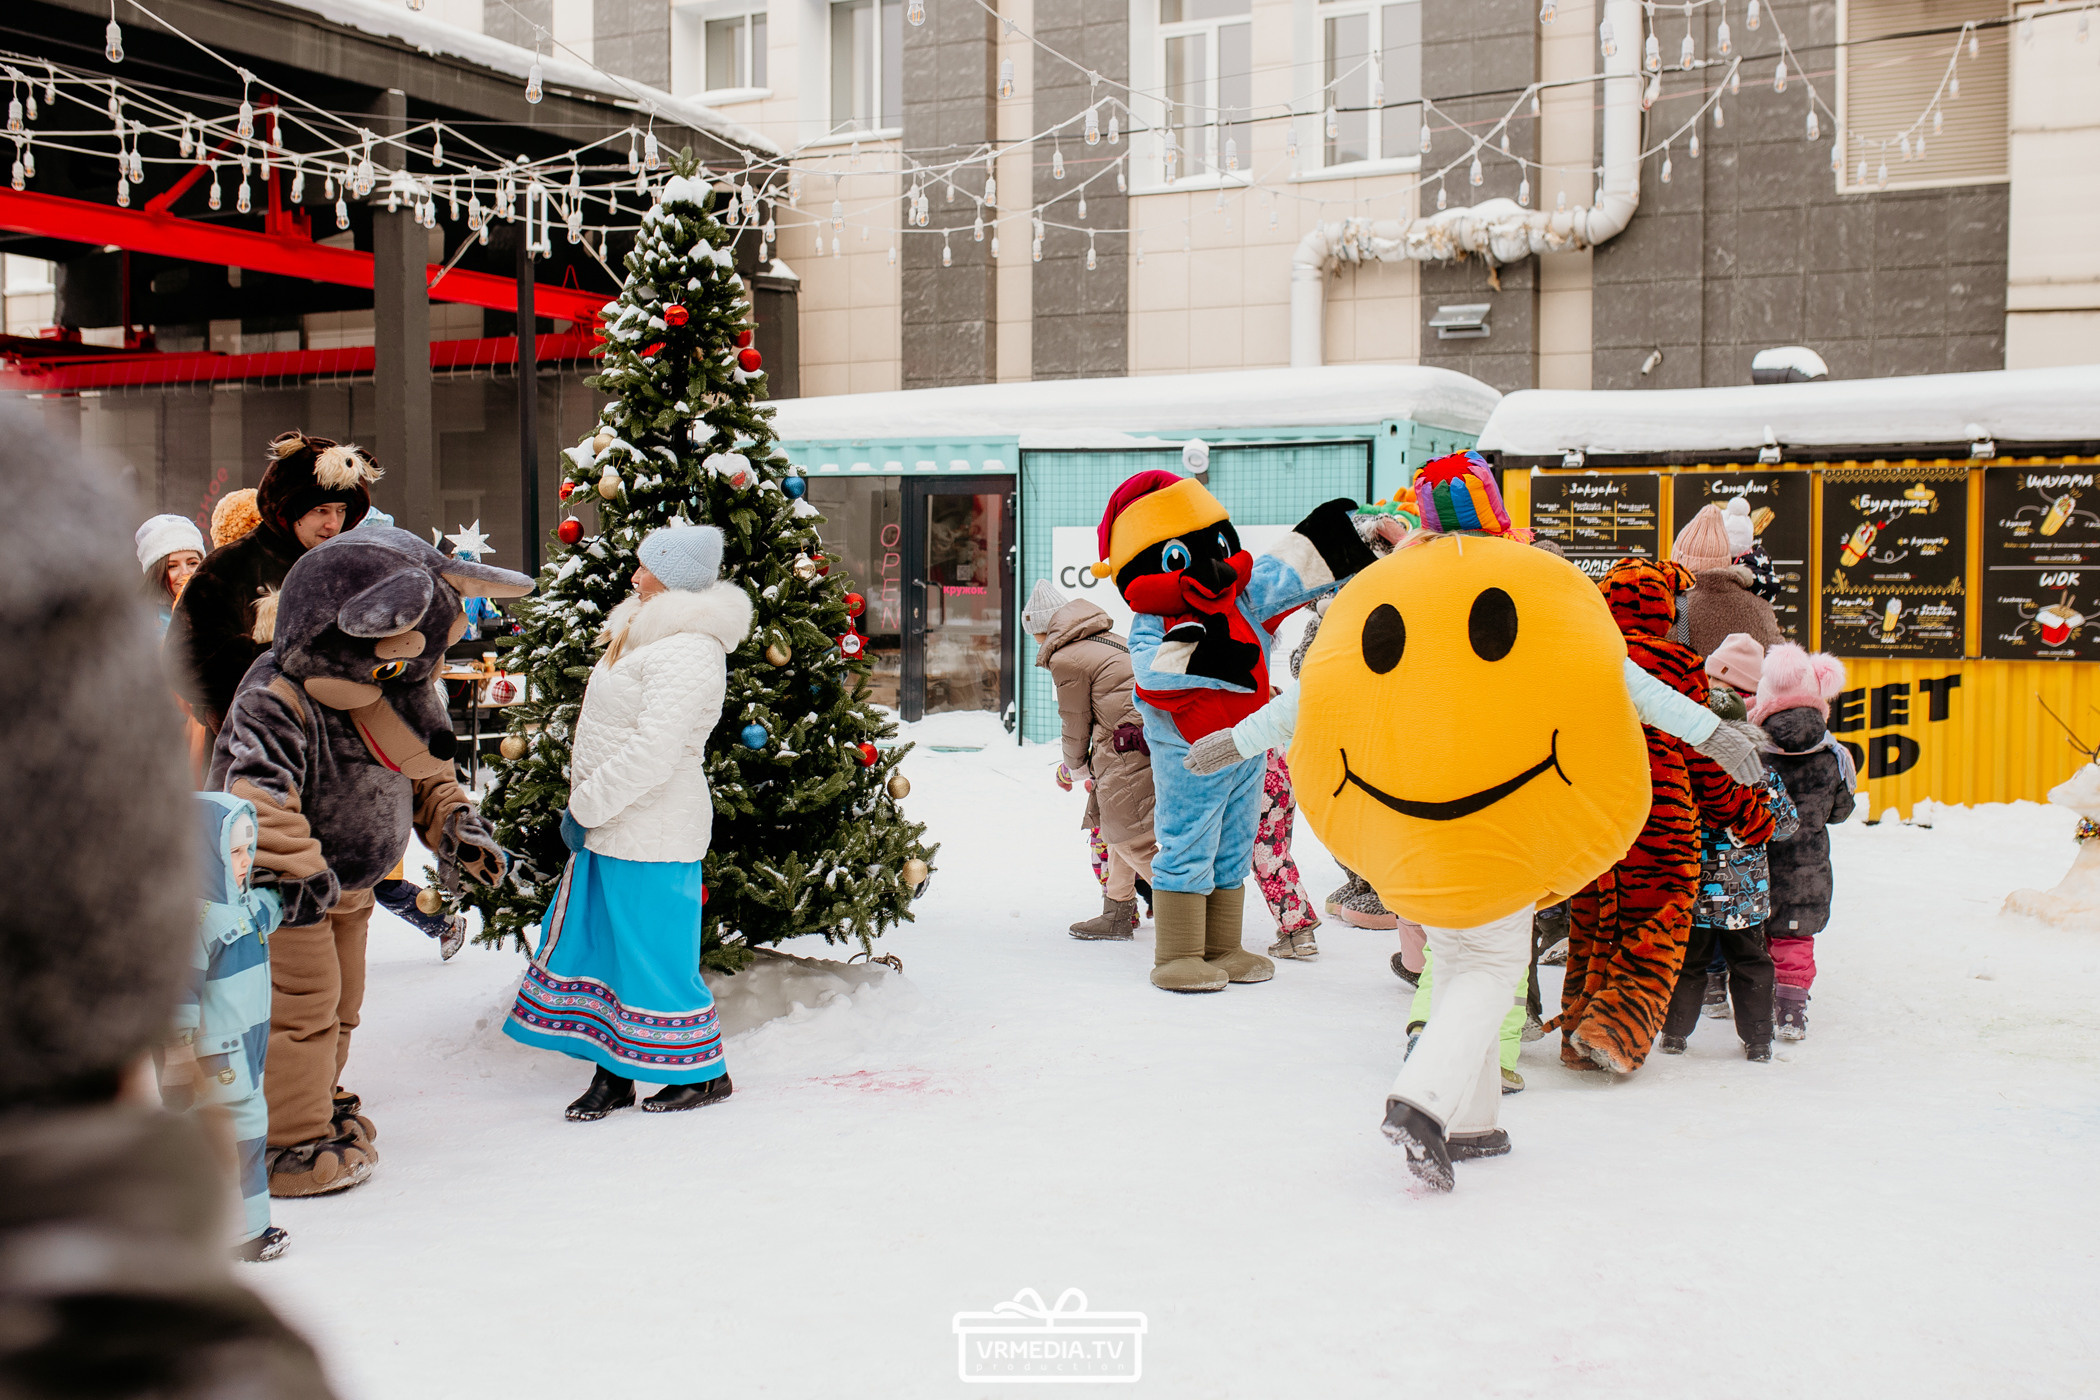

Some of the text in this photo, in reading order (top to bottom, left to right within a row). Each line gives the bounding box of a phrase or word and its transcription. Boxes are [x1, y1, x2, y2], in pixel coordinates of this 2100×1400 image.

[2026, 474, 2094, 489] ШАУРМА
[1569, 483, 1619, 498] Закуски
[1860, 494, 1930, 514] Буррито
[880, 524, 901, 630] OPEN
[2039, 572, 2080, 587] WOK
[943, 586, 987, 597] кружок.
